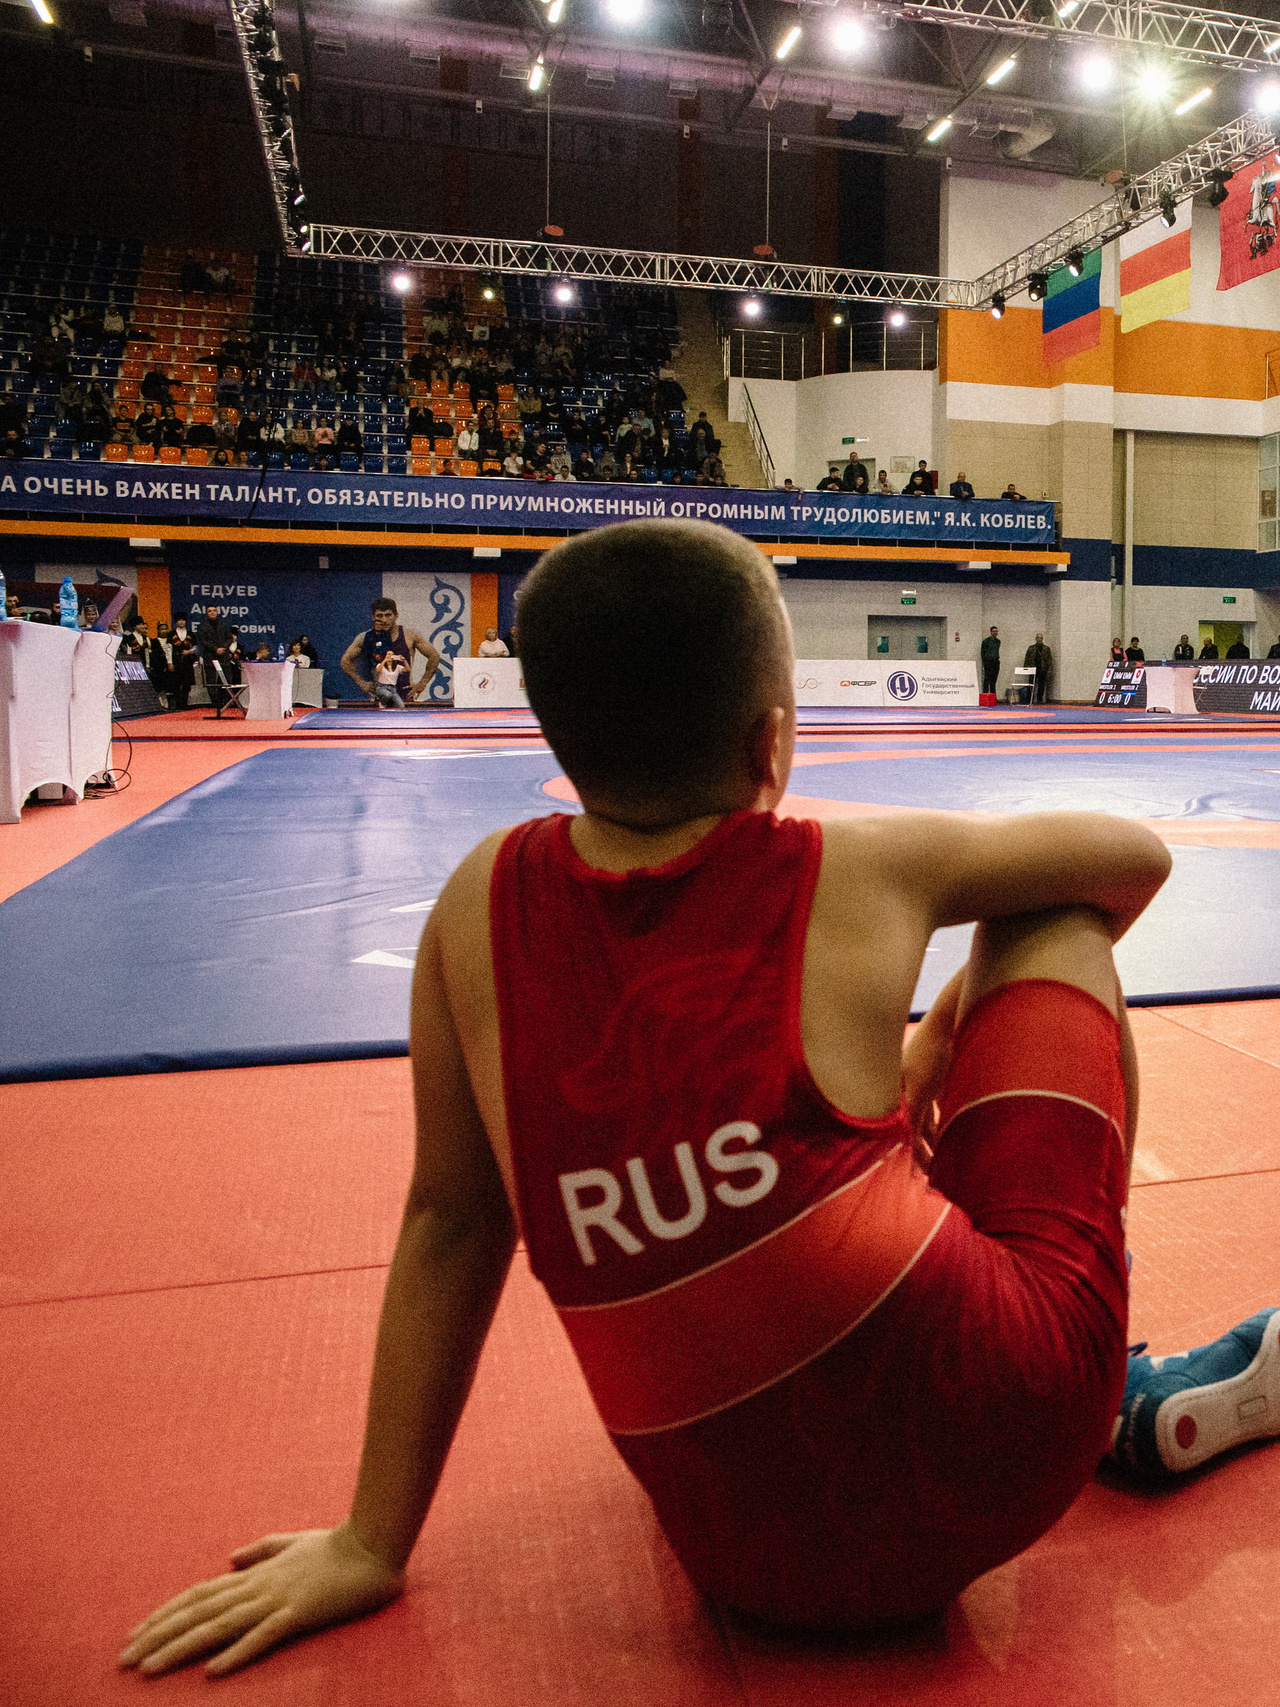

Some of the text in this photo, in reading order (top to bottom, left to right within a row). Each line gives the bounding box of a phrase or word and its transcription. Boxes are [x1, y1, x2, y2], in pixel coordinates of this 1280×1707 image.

[24, 476, 109, 497] ОЧЕНЬ
[115, 480, 200, 500] ВАЖЕН
[206, 484, 301, 506] ТАЛАНТ,
[307, 487, 465, 510] ОБЯЗАТЕЛЬНО
[471, 493, 666, 517] ПРИУМНОЖЕННЫЙ
[670, 501, 786, 521] ОГРОМНЫМ
[945, 511, 976, 527] Я.К.
[980, 513, 1052, 530] КОБЛЕВ.
[190, 584, 258, 599] ГЕДУЕВ
[1236, 665, 1258, 685] ПО
[558, 1120, 779, 1267] RUS
